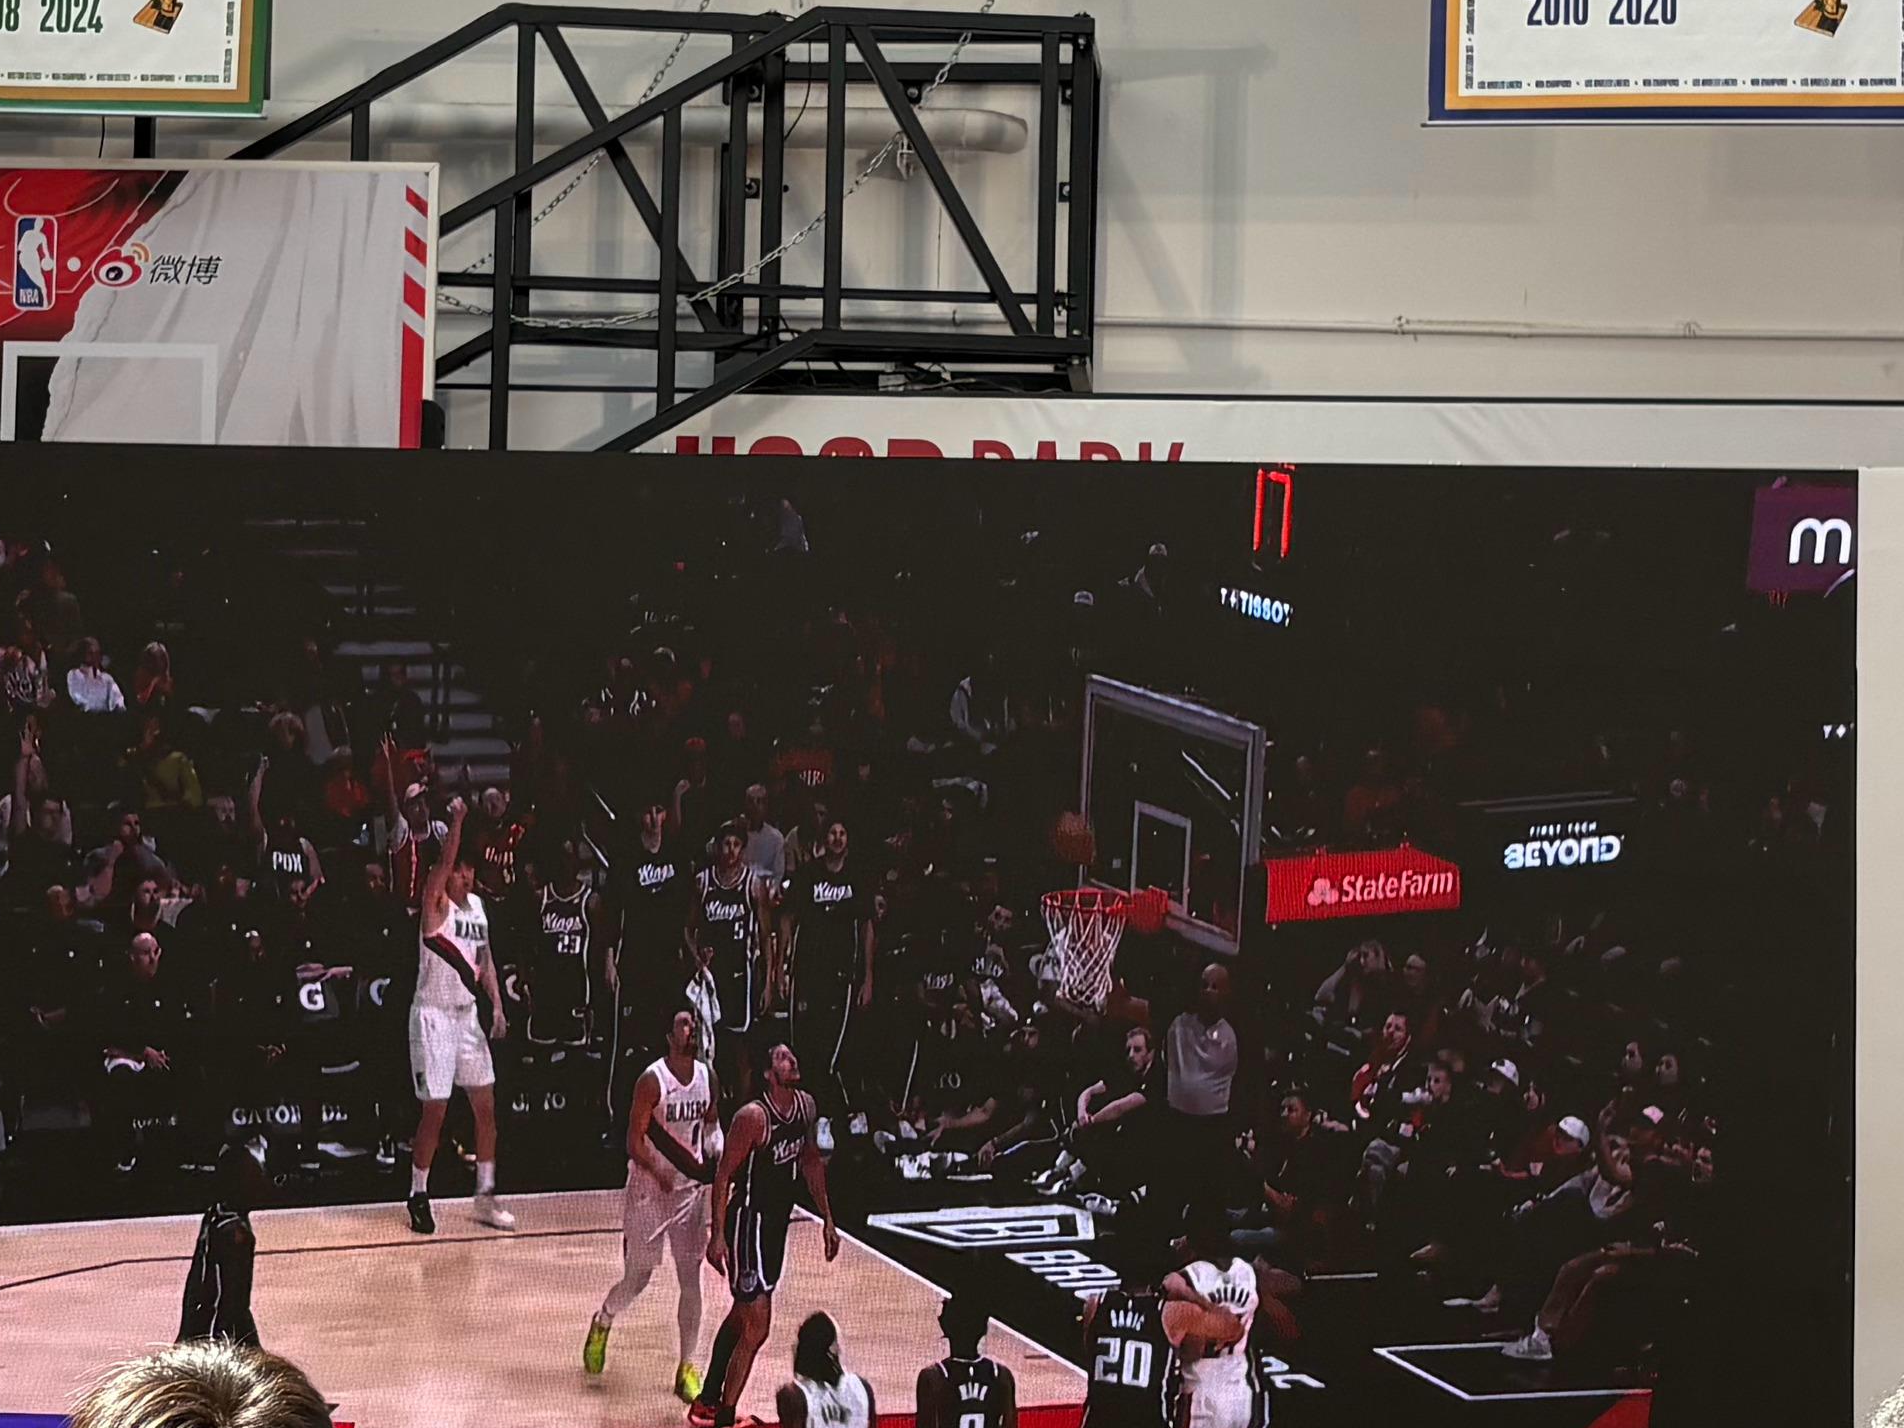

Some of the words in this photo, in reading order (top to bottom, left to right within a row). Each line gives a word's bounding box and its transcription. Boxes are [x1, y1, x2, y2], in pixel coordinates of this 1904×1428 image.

[148, 254, 223, 284] 微博
[18, 288, 39, 304] NBA
[1094, 1337, 1153, 1388] 20
